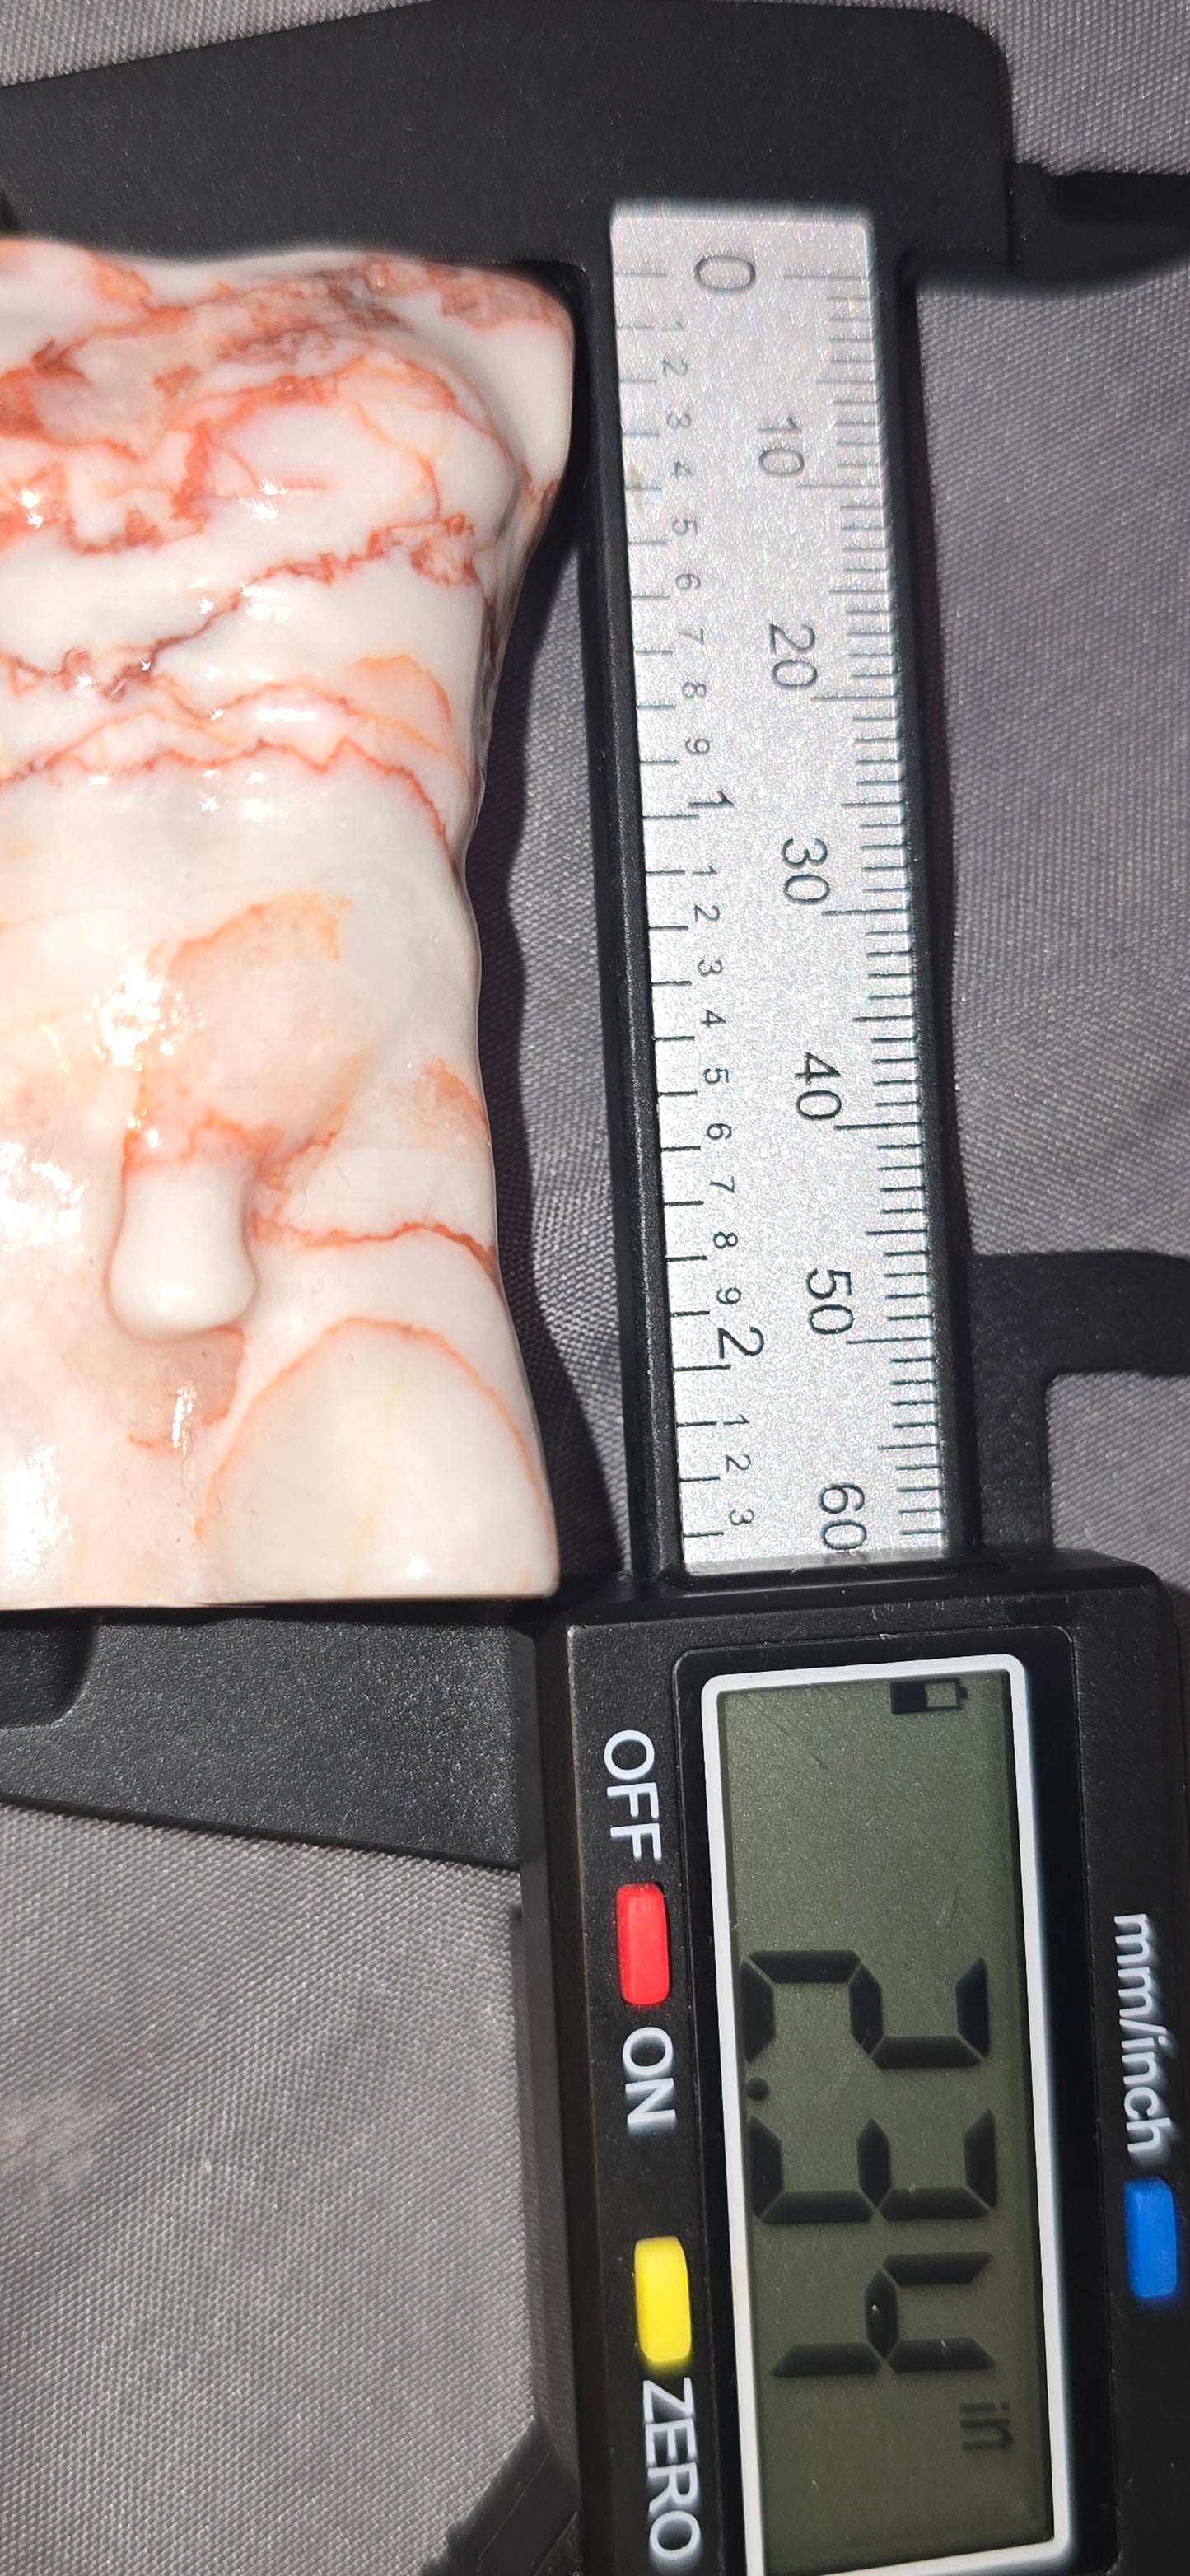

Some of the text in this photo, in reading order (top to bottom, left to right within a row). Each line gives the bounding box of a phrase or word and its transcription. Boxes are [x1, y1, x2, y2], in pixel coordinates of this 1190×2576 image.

[694, 255, 755, 290] 0
[662, 359, 688, 377] 2
[666, 413, 692, 428] 3
[672, 461, 695, 479] 4
[671, 517, 698, 536] 5
[675, 573, 701, 591] 6
[679, 628, 704, 645] 7
[682, 682, 707, 699] 8
[684, 738, 711, 755] 9
[688, 790, 735, 809] 1
[693, 865, 717, 876] 1
[693, 905, 721, 923] 2
[697, 959, 724, 977] 3
[757, 415, 868, 1552] 10 20 30 40 50 60
[700, 1009, 727, 1027] 4
[703, 1067, 730, 1085] 5
[706, 1123, 732, 1141] 6
[709, 1176, 736, 1193] 7
[712, 1231, 739, 1249] 8
[716, 1287, 742, 1305] 9
[717, 1327, 764, 1359] 2
[723, 1414, 750, 1426] 1
[726, 1454, 752, 1472] 2
[728, 1509, 755, 1526] 3
[604, 1729, 664, 1864] OFF
[1113, 1911, 1174, 2156] mm/inch
[623, 2026, 676, 2130] ON
[739, 1949, 1012, 2452] 2.34 in
[641, 2377, 703, 2560] ZERO
